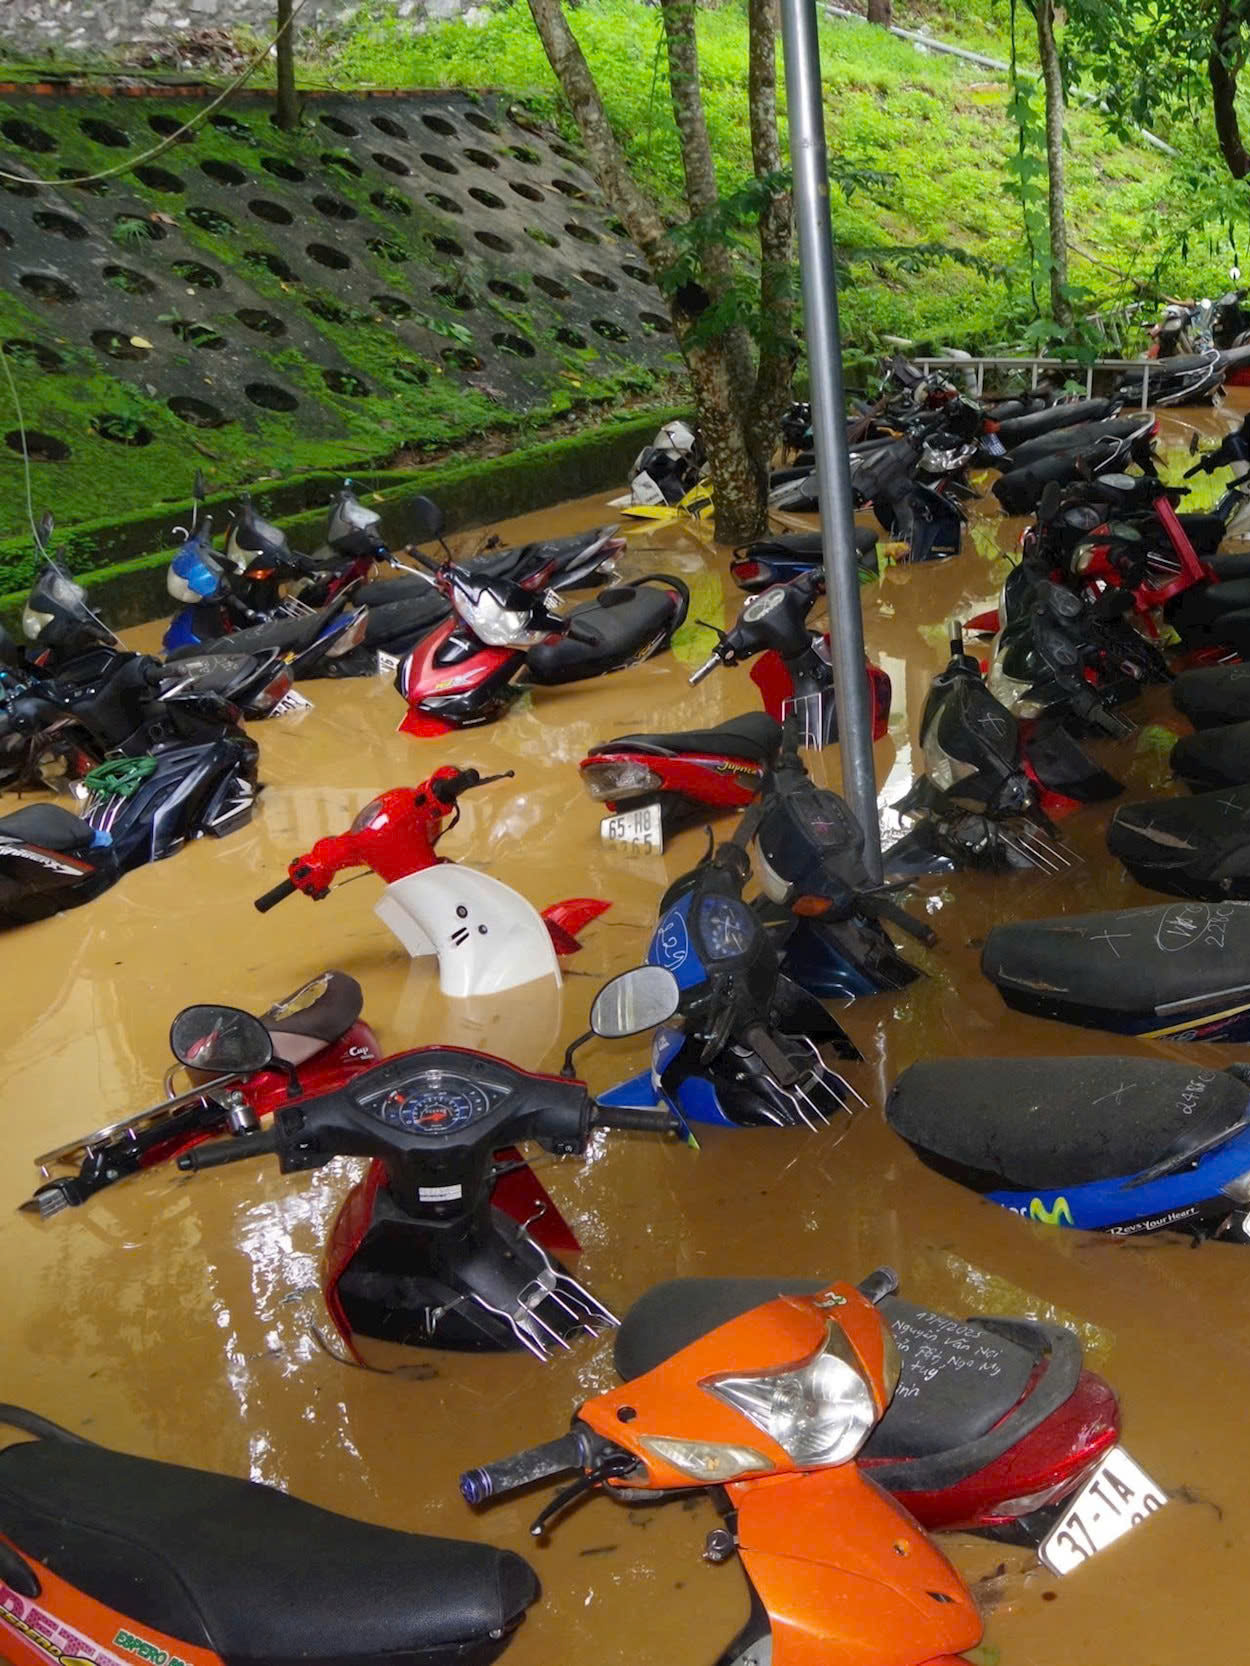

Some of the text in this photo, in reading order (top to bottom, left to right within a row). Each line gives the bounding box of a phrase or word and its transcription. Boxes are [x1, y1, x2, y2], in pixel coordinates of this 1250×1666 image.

[608, 809, 651, 840] 65-H8
[349, 1046, 369, 1056] Cup
[1167, 1205, 1198, 1222] Heart
[1056, 1467, 1136, 1560] 37-TA
